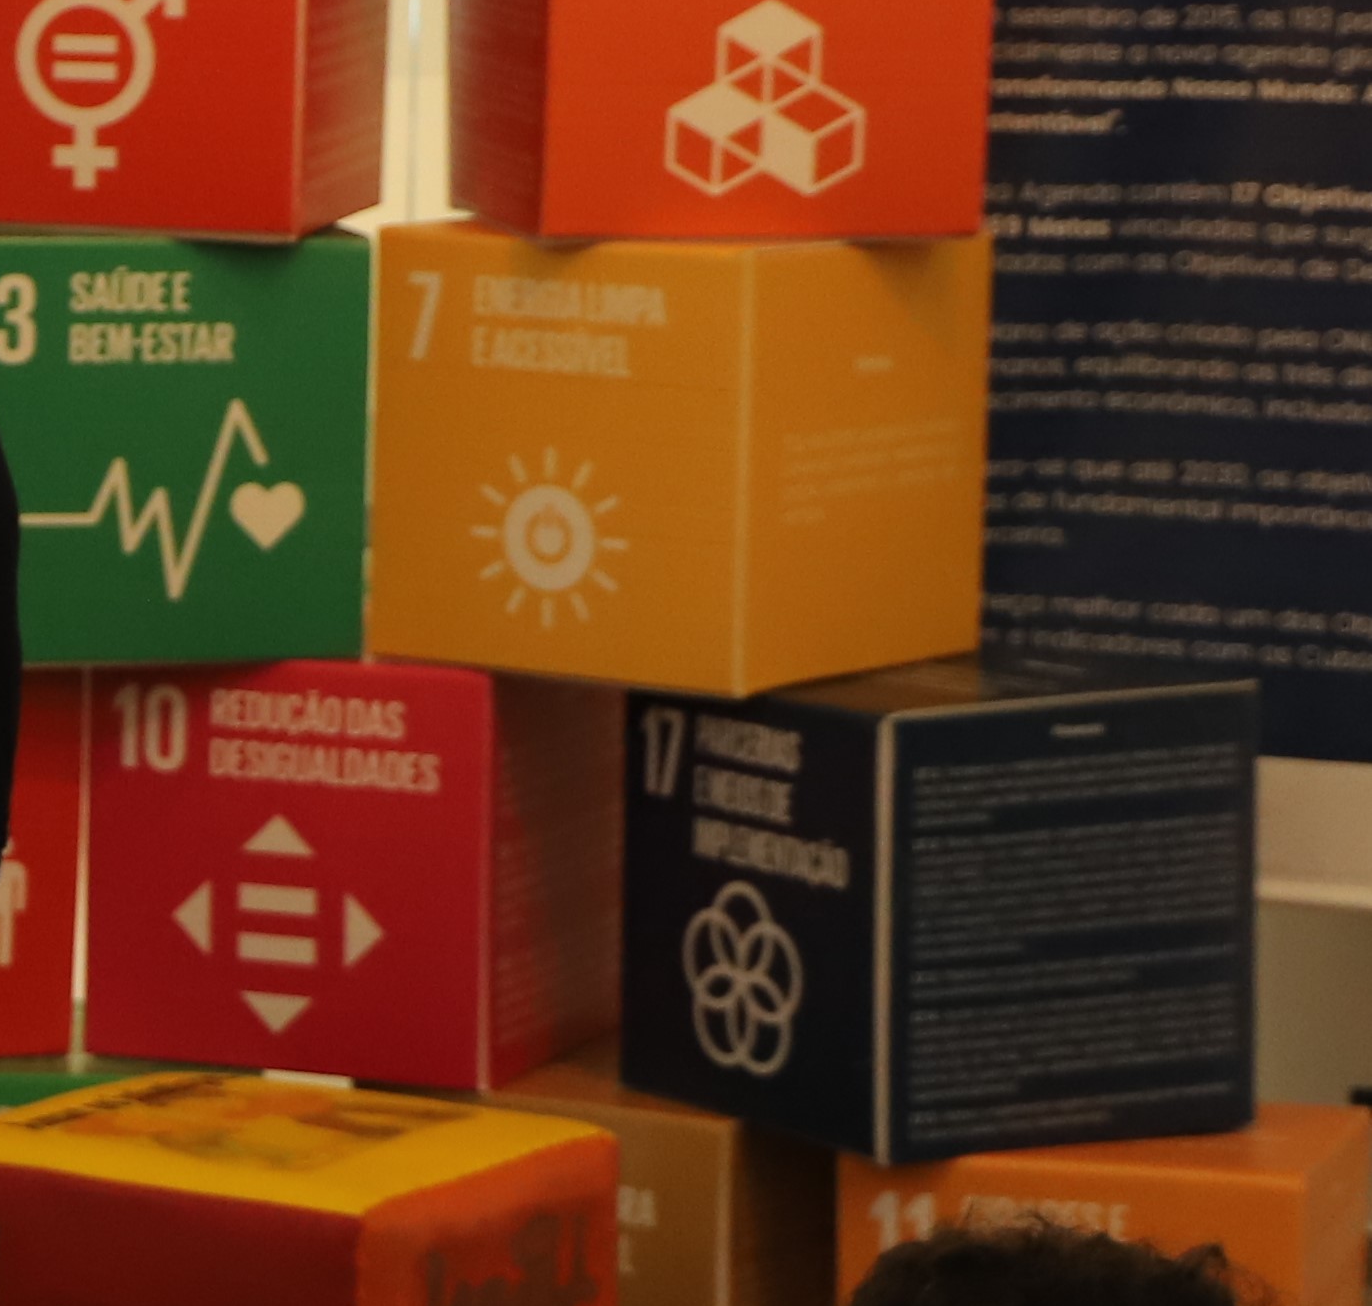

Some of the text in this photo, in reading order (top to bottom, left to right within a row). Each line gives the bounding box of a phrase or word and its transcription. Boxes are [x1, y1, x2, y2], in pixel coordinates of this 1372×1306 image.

[68, 265, 192, 313] SAÚDE E
[407, 270, 444, 361] 7
[113, 683, 188, 772] 10
[209, 689, 408, 740] REDUÇÃO DAS
[208, 736, 442, 793] DESIGUALDADES
